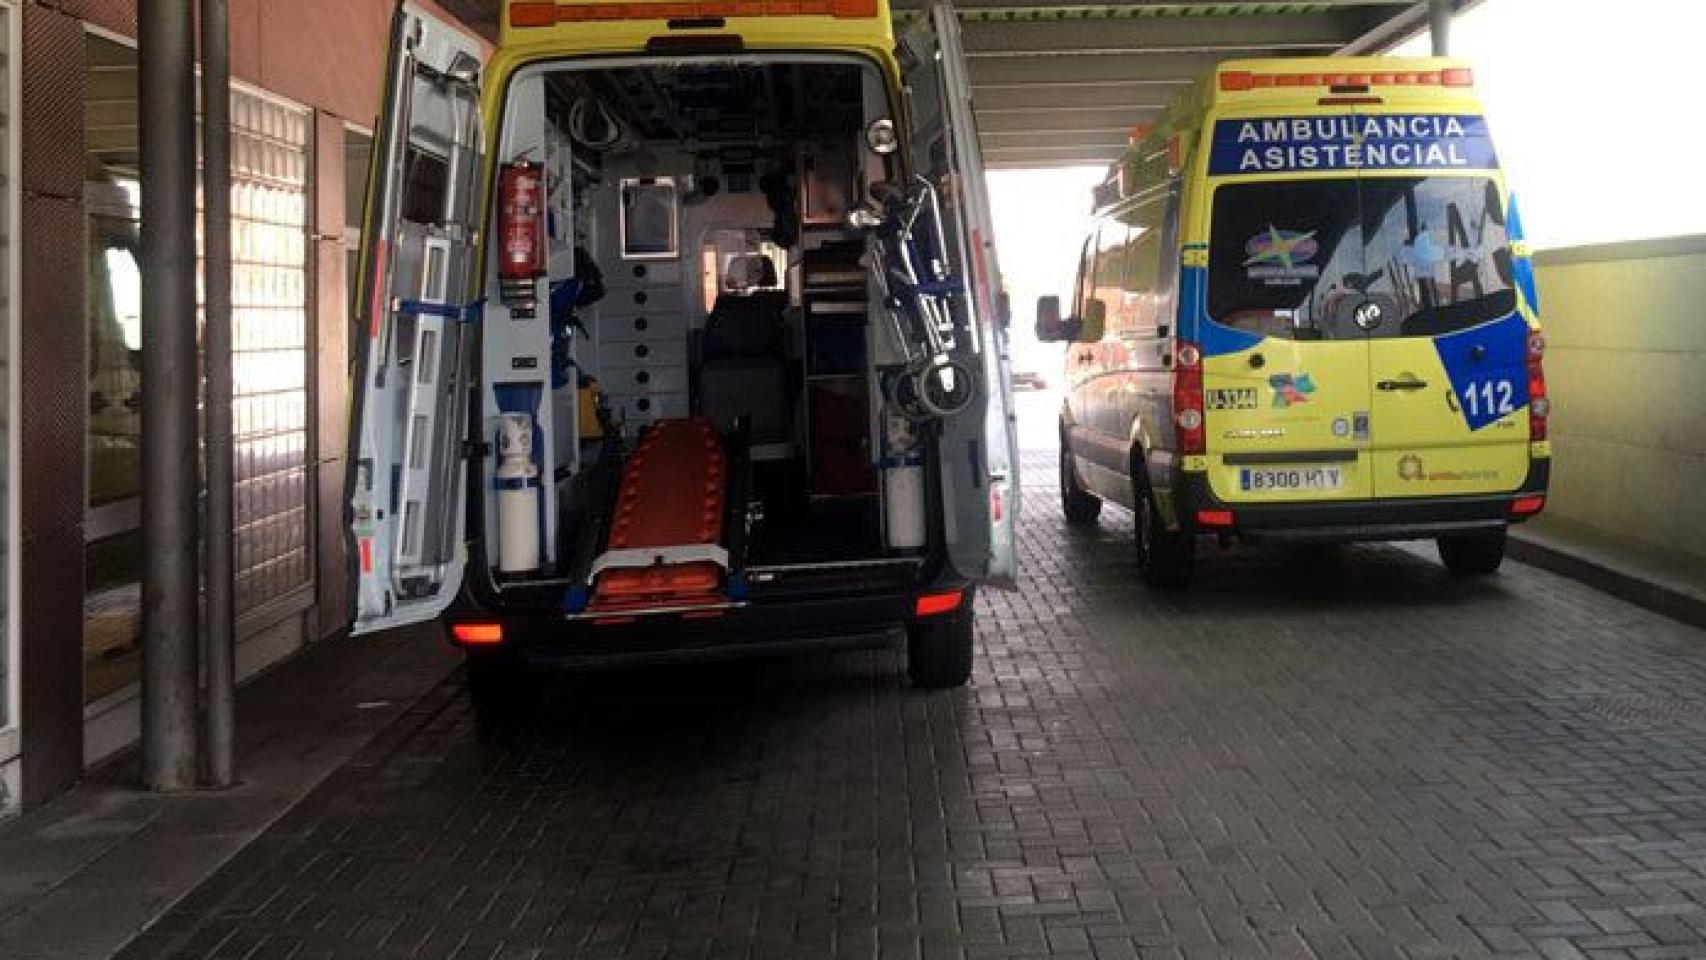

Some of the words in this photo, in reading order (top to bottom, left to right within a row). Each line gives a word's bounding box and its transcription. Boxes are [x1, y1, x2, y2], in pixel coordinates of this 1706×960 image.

[1238, 117, 1465, 143] AMBULANCIA
[1239, 143, 1467, 170] ASISTENCIAL
[1465, 381, 1513, 416] 112
[1254, 470, 1299, 488] 8300
